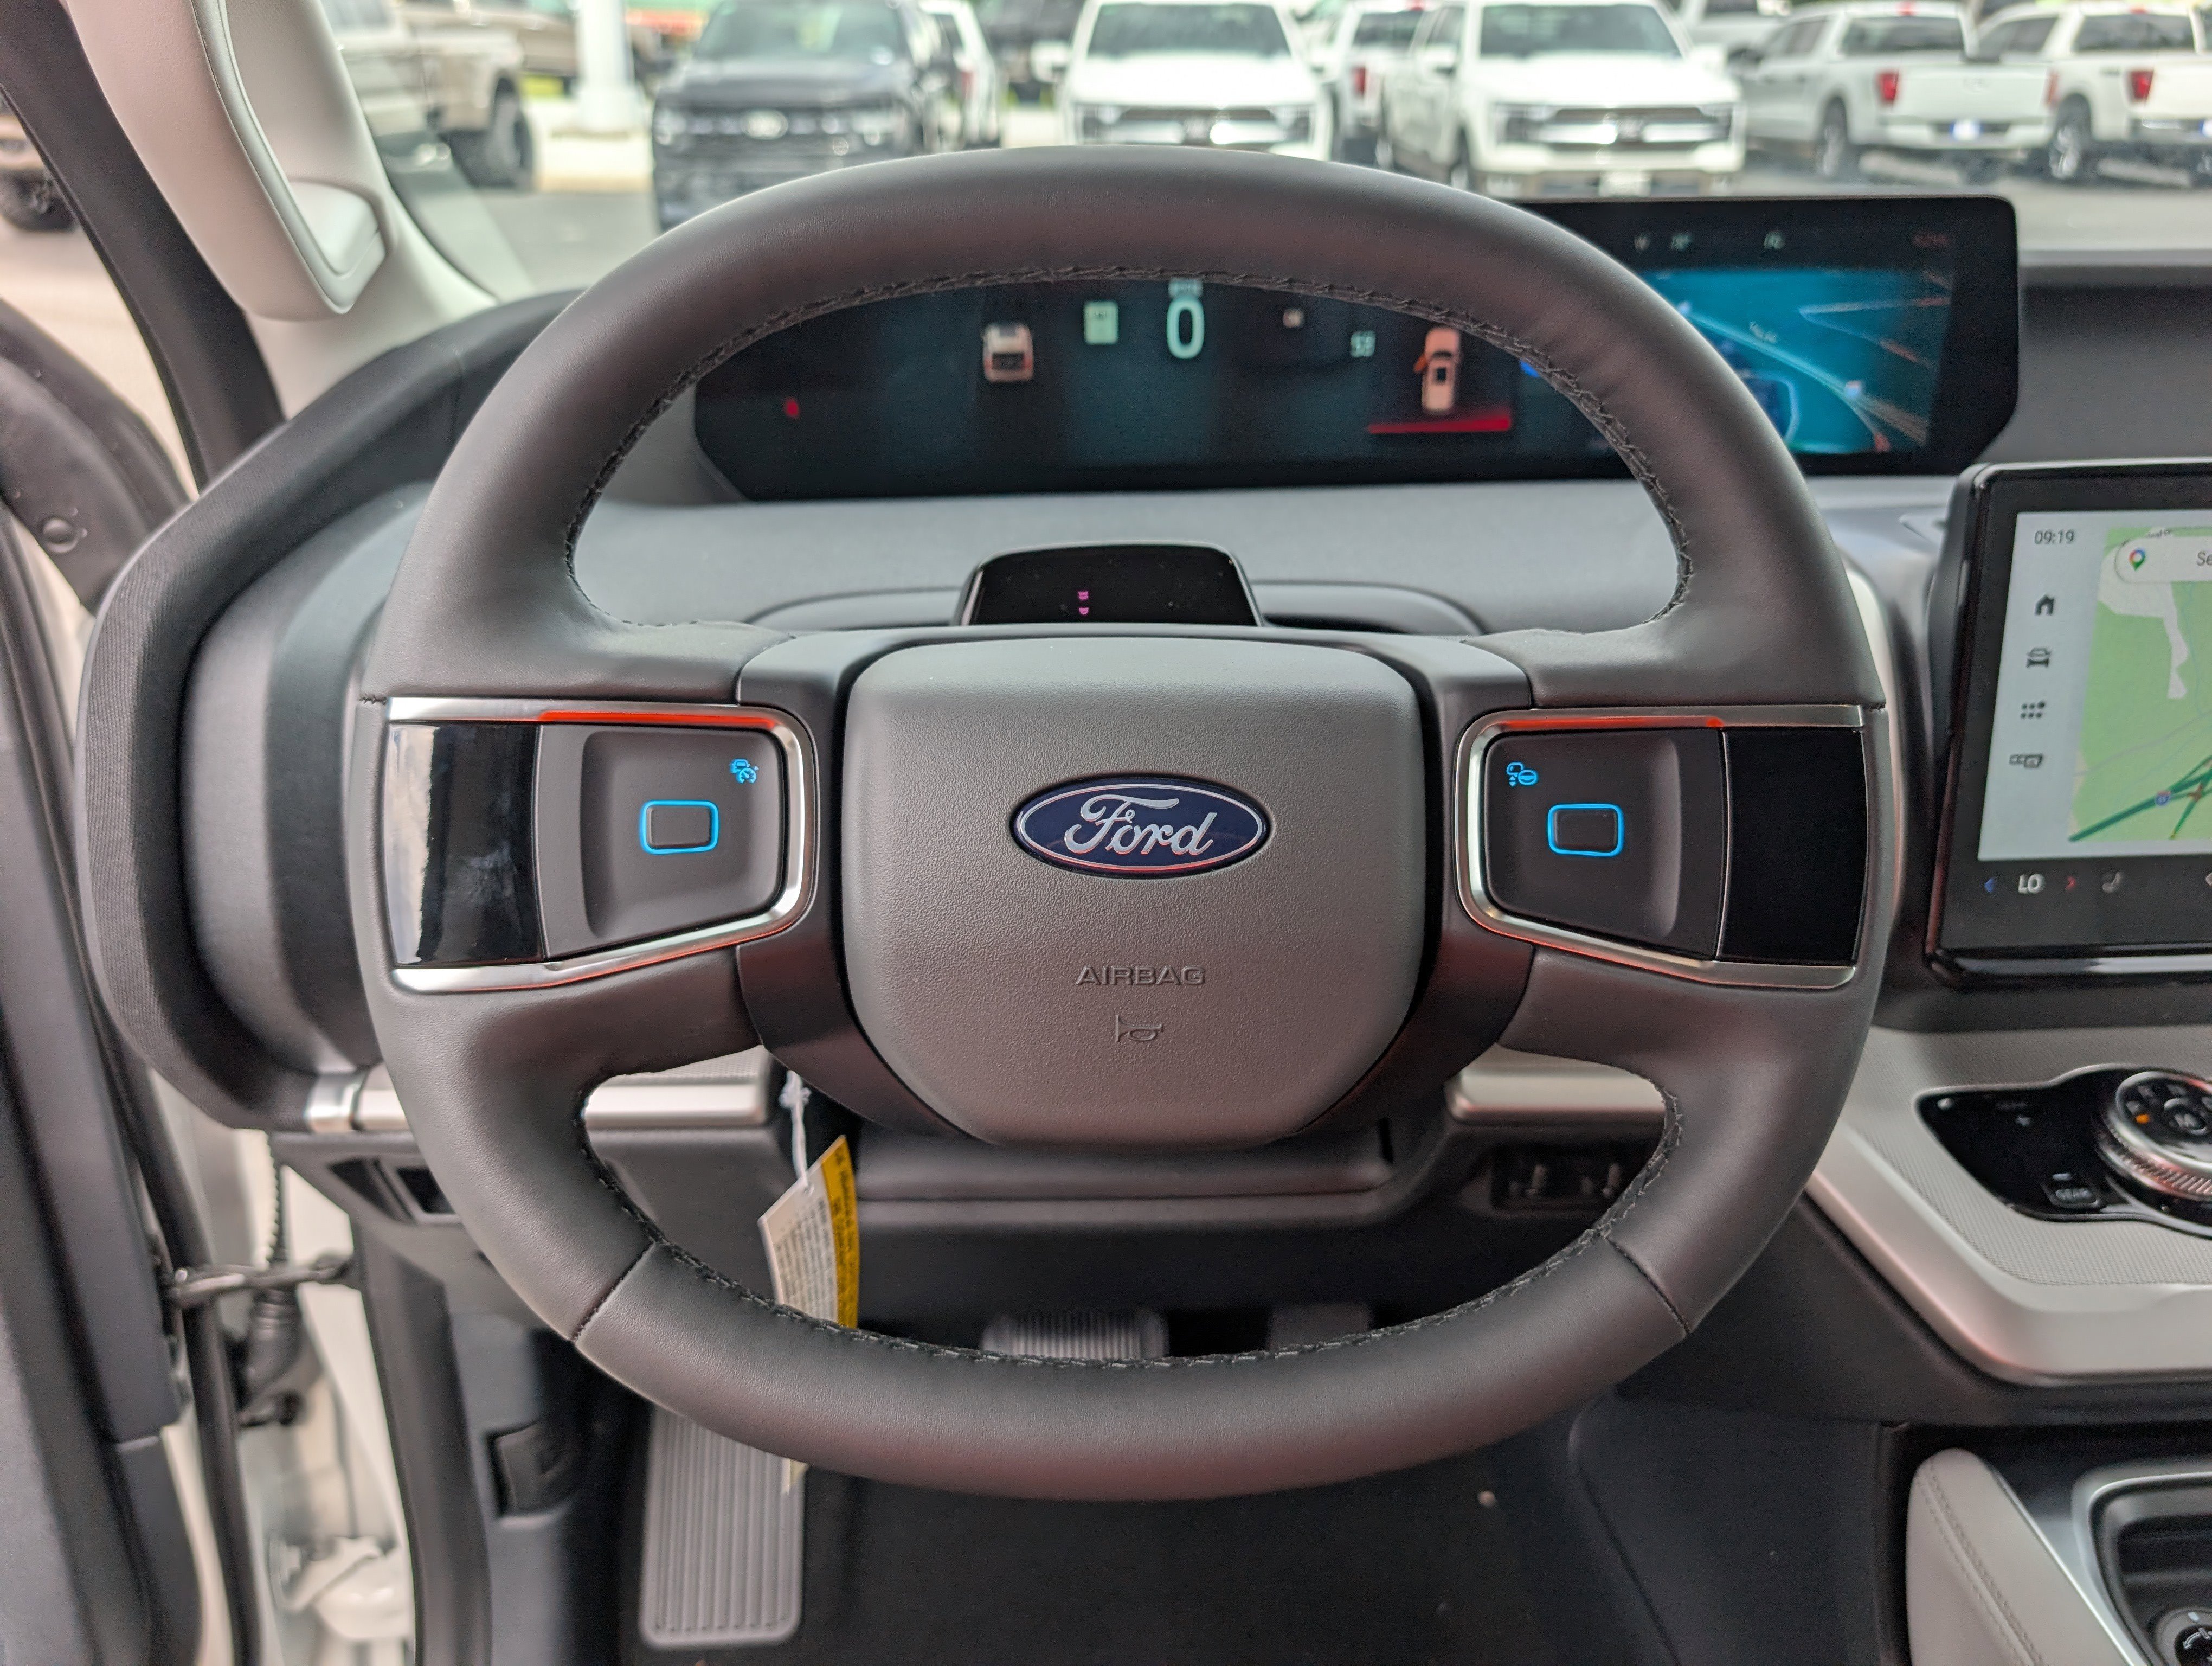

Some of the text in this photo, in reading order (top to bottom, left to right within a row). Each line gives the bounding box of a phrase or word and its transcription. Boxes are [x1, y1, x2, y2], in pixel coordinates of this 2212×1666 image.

[1167, 298, 1205, 359] 0
[2034, 529, 2075, 544] 09:19
[1064, 794, 1218, 855] Ford
[2017, 874, 2046, 894] LO
[1075, 965, 1206, 986] AIRBAG
